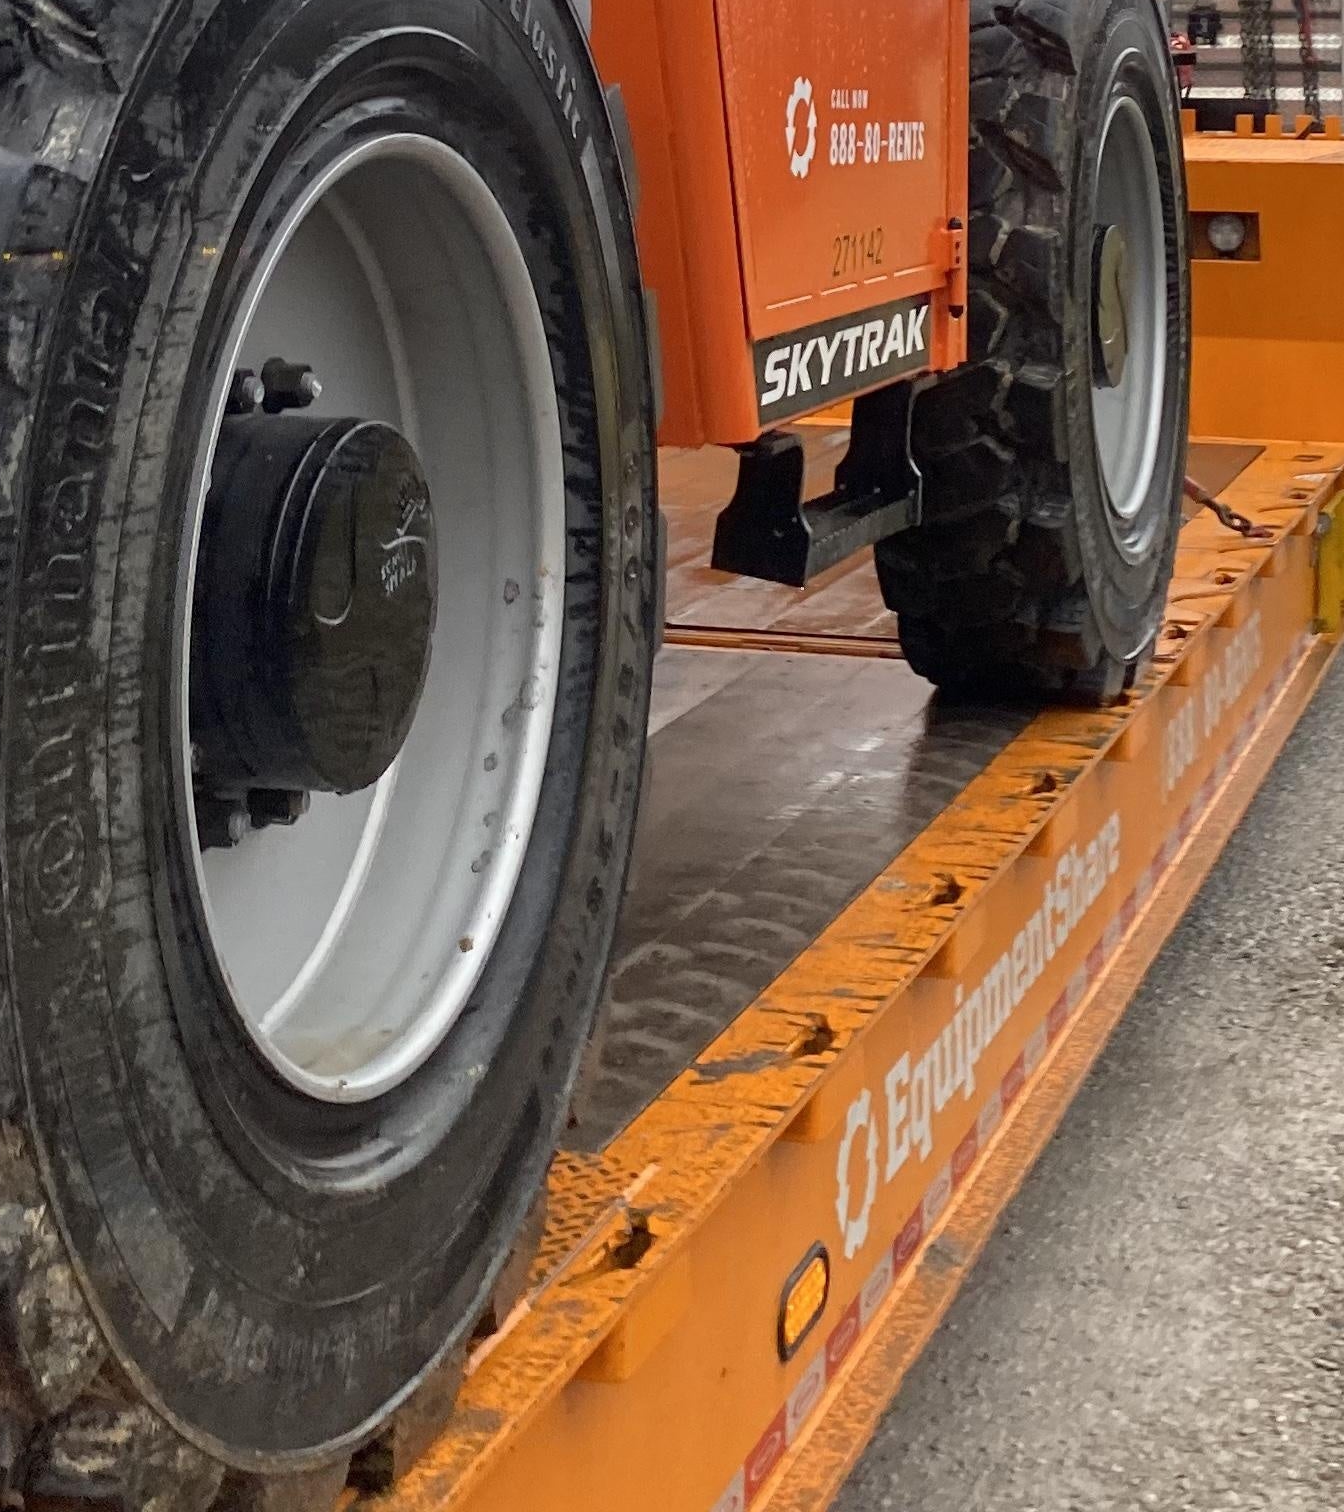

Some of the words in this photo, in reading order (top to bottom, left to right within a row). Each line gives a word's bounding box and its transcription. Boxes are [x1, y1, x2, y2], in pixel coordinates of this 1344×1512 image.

[831, 88, 850, 109] CALL
[852, 89, 869, 109] NOW
[829, 121, 925, 166] 888-80-RENTS
[832, 226, 885, 277] 271142
[761, 304, 929, 406] SKYTRAK
[885, 811, 1121, 1183] EquipmentShare
